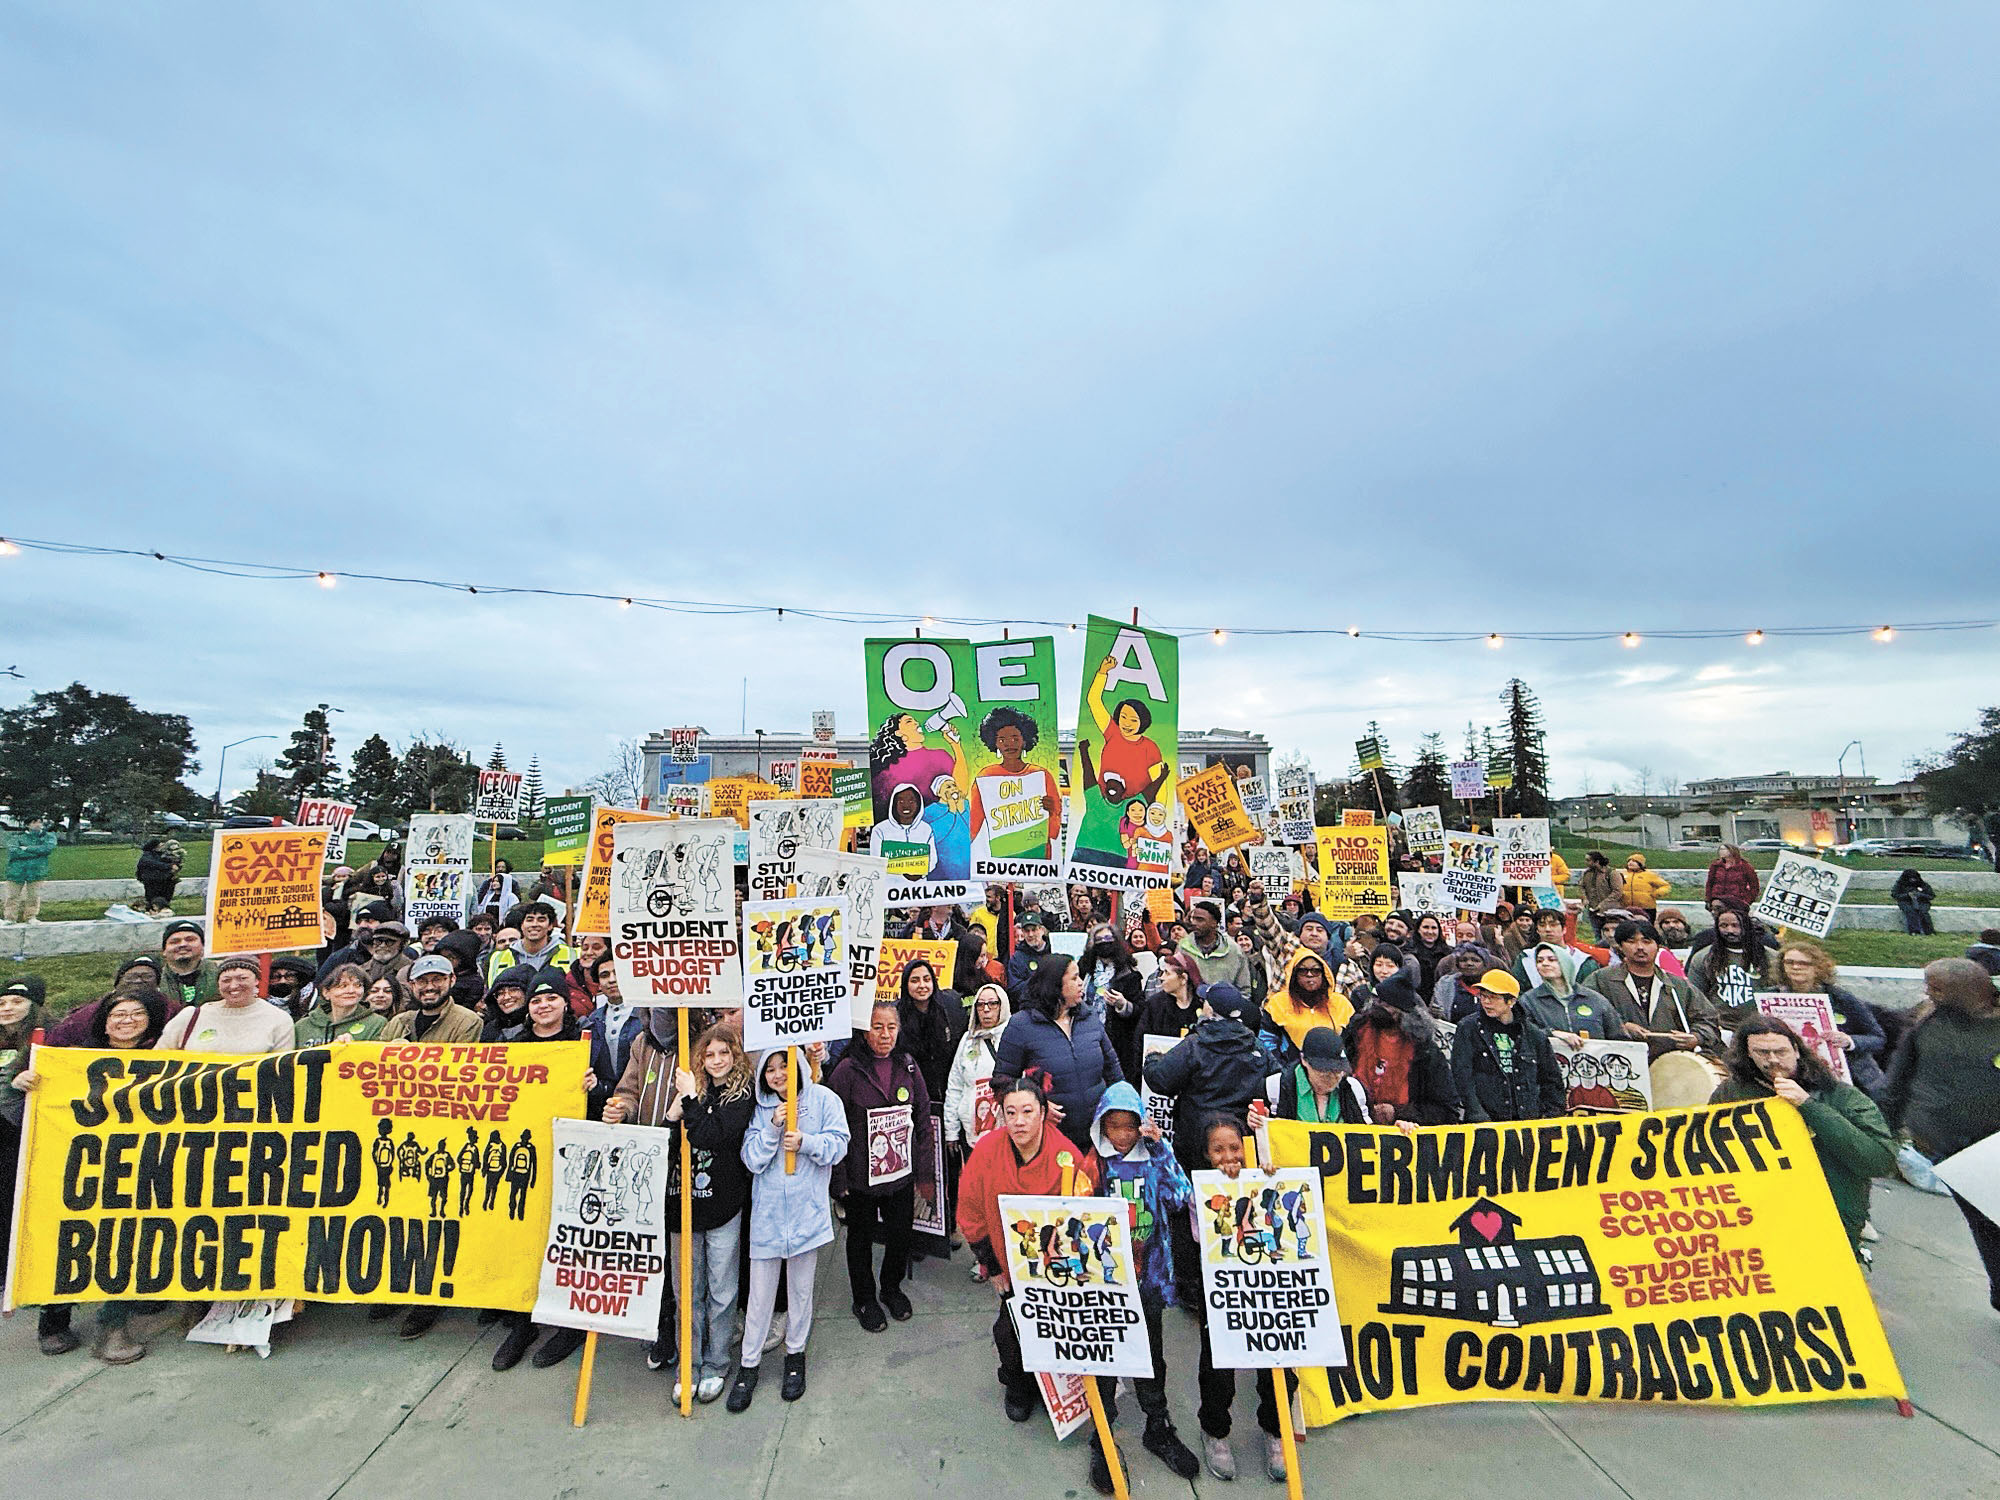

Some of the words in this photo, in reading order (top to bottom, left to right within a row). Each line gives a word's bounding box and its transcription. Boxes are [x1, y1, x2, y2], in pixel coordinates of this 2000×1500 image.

[975, 641, 1040, 702] E
[1103, 627, 1168, 702] A
[882, 642, 954, 711] O
[672, 730, 685, 747] ICE
[685, 730, 698, 748] OUT
[771, 763, 782, 780] ICE
[782, 763, 795, 781] OUT
[814, 767, 831, 776] W
[835, 772, 864, 784] STUDENT
[479, 772, 501, 797] ICE
[501, 773, 522, 799] OUT
[804, 784, 832, 793] WA
[835, 782, 866, 793] CENTERED
[999, 778, 1023, 800] ON
[1191, 779, 1215, 793] WE
[1279, 785, 1308, 798] KEEP
[549, 802, 583, 814] STUDENT
[667, 805, 699, 815] KEEP
[1191, 791, 1227, 813] WAIT
[297, 801, 327, 827] ICE
[327, 806, 354, 836] OUT
[475, 809, 517, 820] SCHOOLS
[548, 812, 586, 826] CENTERED
[990, 796, 1044, 831] STRIKE
[554, 824, 584, 836] BUDGET
[1409, 831, 1440, 841] KEEP
[251, 839, 303, 855] WE
[557, 838, 578, 848] NOW!
[1144, 840, 1160, 849] WE
[1336, 837, 1369, 848] NO
[1410, 845, 1444, 853] OAKLAND
[224, 852, 323, 871] CAN'T
[1331, 849, 1379, 861] PODEMOS
[225, 867, 313, 884] WAIT
[592, 865, 612, 876] INVES
[976, 859, 1059, 878] EDUCATION
[1068, 867, 1168, 890] ASSOCIATION
[1336, 862, 1378, 875] ESPERAR
[1447, 871, 1496, 885] STUDENT
[1509, 873, 1536, 881] NOW!
[590, 876, 605, 885] OUR
[1264, 877, 1289, 886] EEP
[1443, 877, 1497, 892] CENTERED
[220, 888, 250, 898] INVEST
[253, 888, 262, 896] IN
[264, 886, 279, 896] THE
[281, 884, 314, 894] SCHOOLS
[220, 898, 237, 908] OUR
[240, 895, 281, 906] STUDENTS
[282, 893, 316, 904] DESERVE
[887, 884, 966, 900] OAKLAND
[1266, 892, 1288, 900] LAND
[1447, 886, 1490, 899] BUDGET
[1453, 894, 1482, 906] NOW!
[1767, 887, 1831, 914] KEEP
[408, 910, 463, 918] CENTERED
[412, 902, 460, 910] STUDENT
[1766, 899, 1811, 919] TEACHERS
[1814, 914, 1826, 922] IN
[1759, 904, 1824, 932] OAKLAND
[621, 920, 729, 941] STUDENT
[614, 939, 737, 960] CENTERED
[892, 948, 930, 961] WE
[632, 958, 725, 978] BUDGET
[877, 961, 945, 977] CAT
[1716, 964, 1751, 986] WEST
[651, 978, 711, 995] NOW!
[754, 971, 841, 992] STUDENT
[748, 985, 847, 1009] CENTERED
[761, 1001, 836, 1022] BUDGET
[775, 1016, 824, 1036] NOW!
[381, 1046, 444, 1064] FOR
[450, 1046, 509, 1064] THE
[338, 1061, 479, 1081] SCHOOLS
[482, 1064, 549, 1084] OUR
[70, 1050, 331, 1127] STUDENT
[360, 1080, 520, 1102] STUDENTS
[372, 1099, 510, 1121] DESERVE
[1309, 1121, 1622, 1205] PERMANENT
[1630, 1101, 1792, 1180] STAFF!
[62, 1131, 362, 1211] CENTERED
[1600, 1189, 1669, 1214] FOR
[1671, 1184, 1741, 1206] THE
[1600, 1206, 1753, 1238] SCHOOLS
[556, 1223, 657, 1253] STUDENT
[1654, 1234, 1720, 1259] OUR
[54, 1214, 290, 1295] BUDGET
[303, 1214, 460, 1298] NOW!
[547, 1243, 663, 1275] CENTERED
[1214, 1268, 1320, 1288] STUDENT
[1609, 1248, 1764, 1288] STUDENTS
[556, 1268, 648, 1296] BUDGET
[1624, 1274, 1776, 1308] DESERVE
[569, 1290, 629, 1317] NOW!
[1024, 1287, 1129, 1307] STUDENT
[1210, 1288, 1330, 1309] CENTERED
[1020, 1302, 1140, 1325] CENTERED
[1226, 1309, 1319, 1330] BUDGET
[1036, 1321, 1128, 1343] BUDGET
[1246, 1331, 1306, 1352] NOW!
[1054, 1341, 1114, 1362] NOW!
[1327, 1321, 1425, 1408] NOT
[1444, 1306, 1867, 1400] CONTRACTORS!
